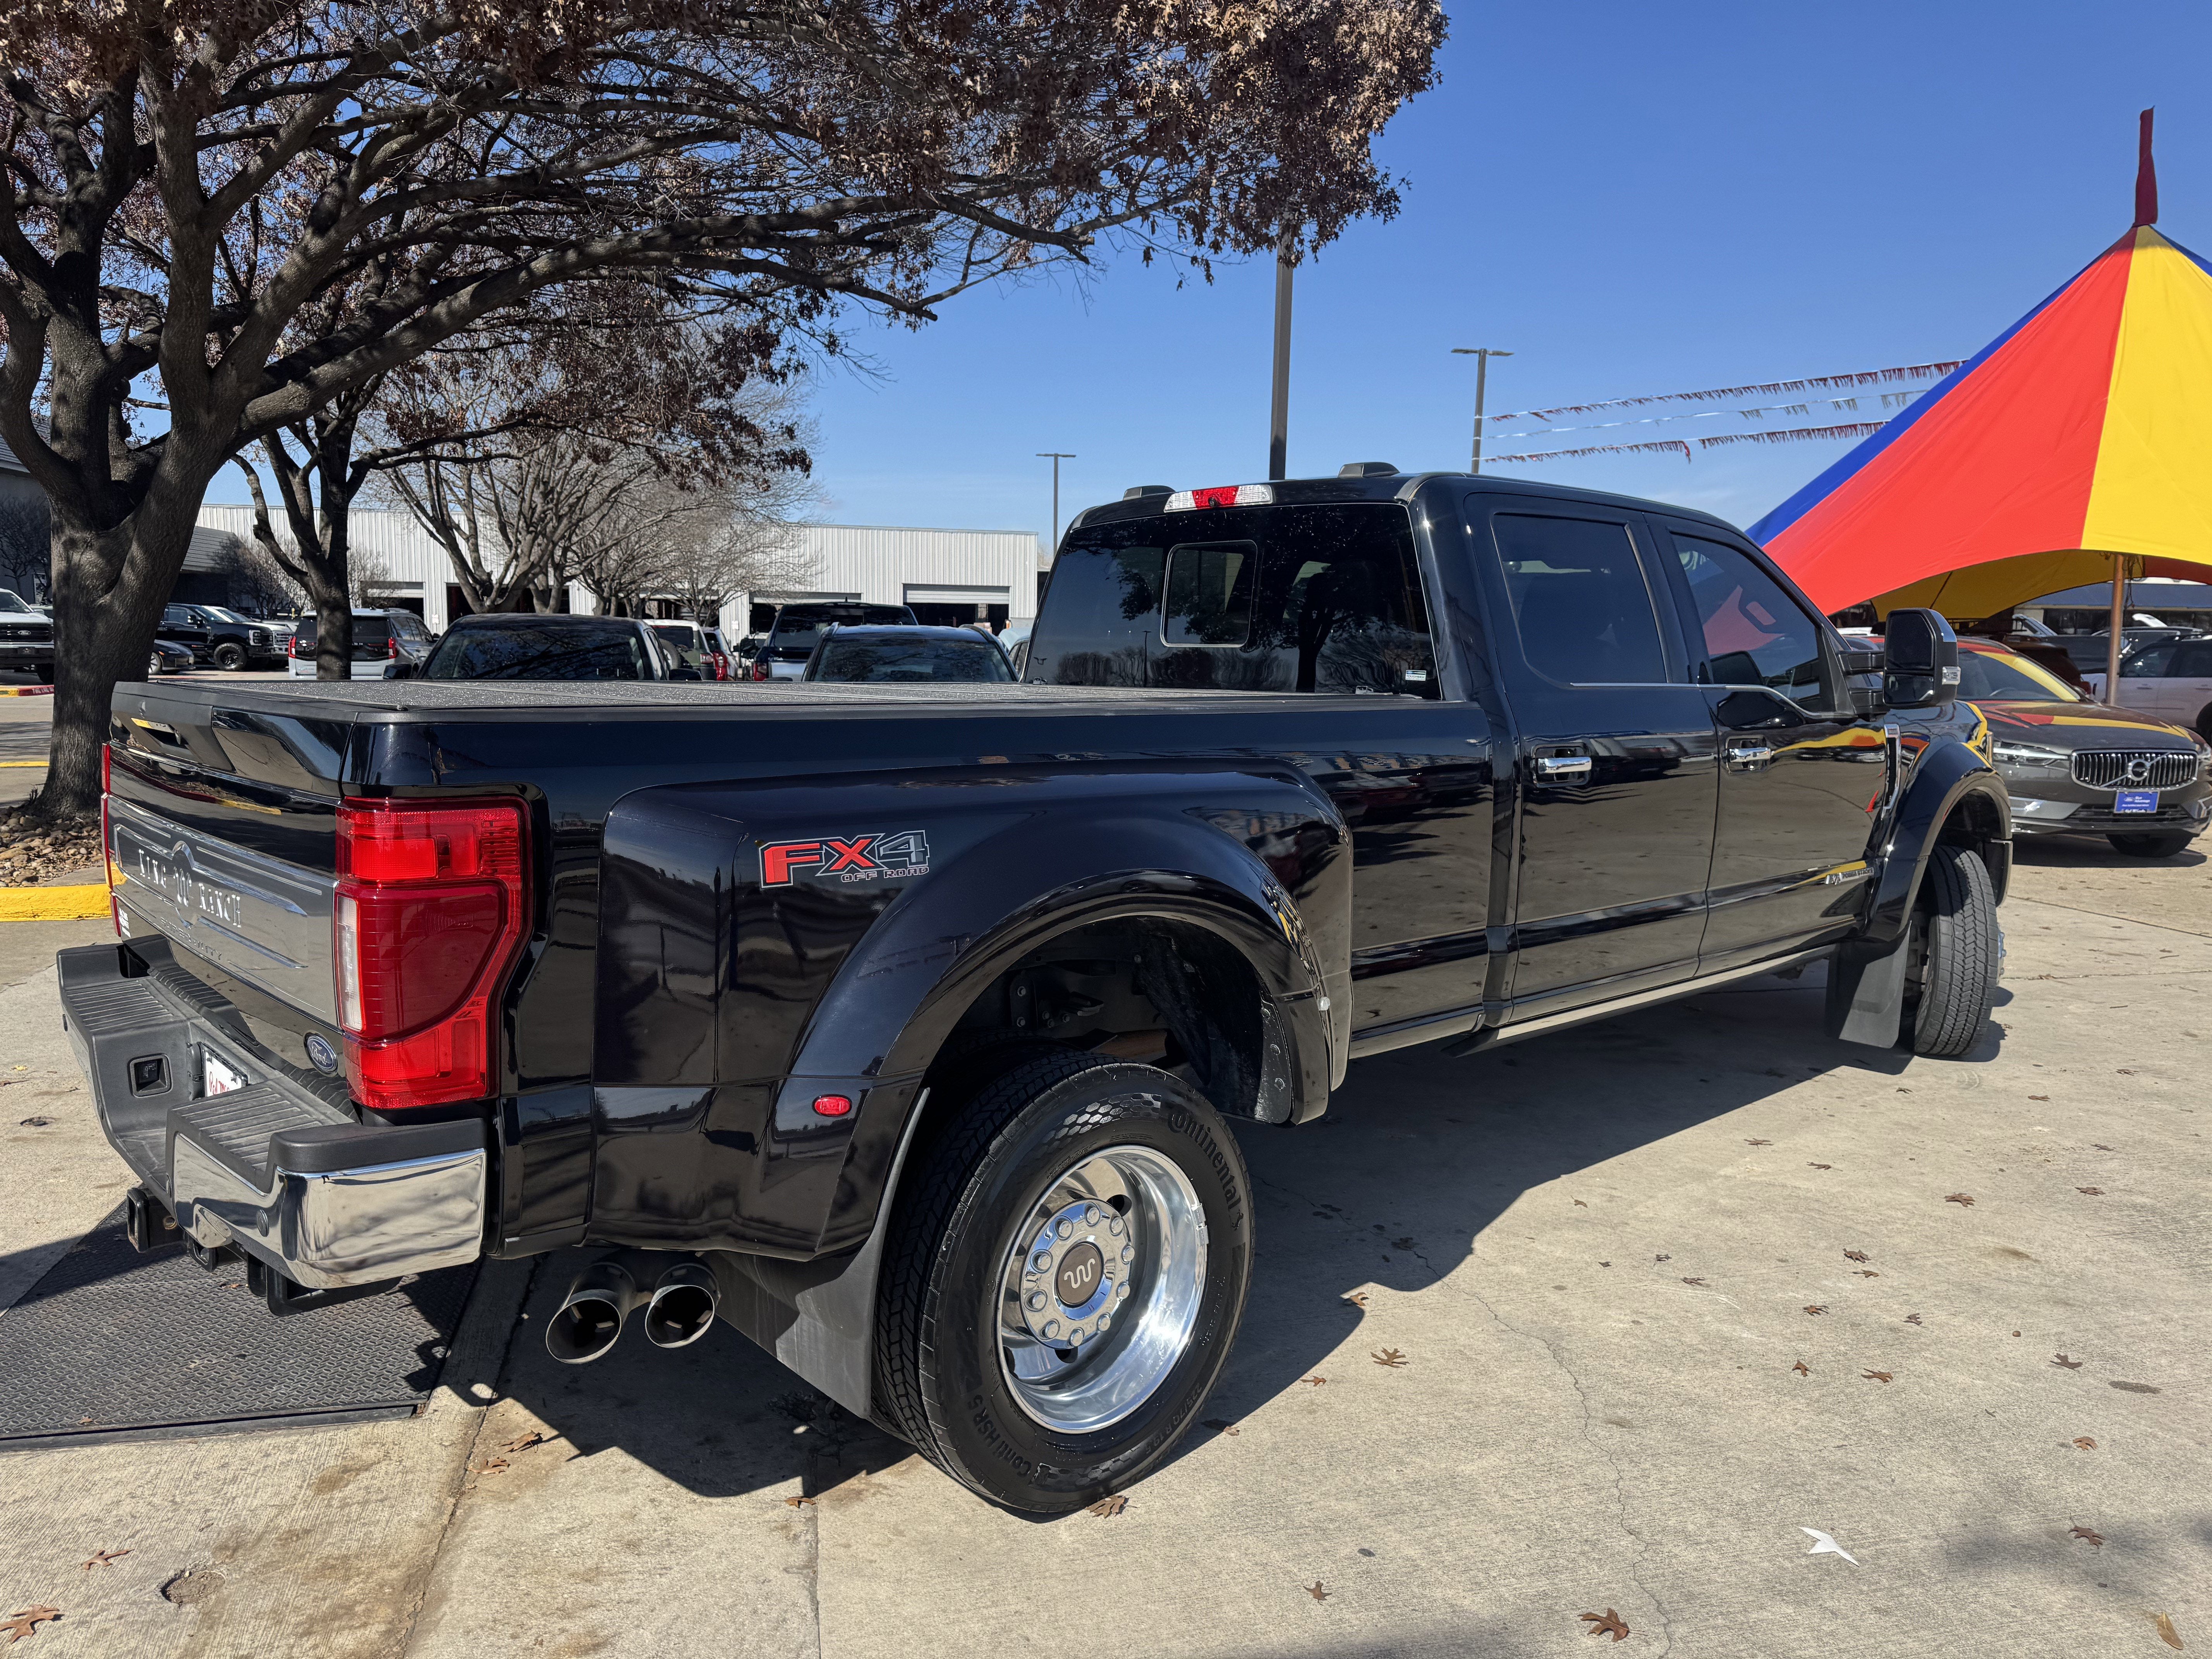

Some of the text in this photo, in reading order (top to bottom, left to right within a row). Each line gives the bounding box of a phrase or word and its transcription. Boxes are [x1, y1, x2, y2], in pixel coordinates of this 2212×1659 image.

[759, 830, 930, 888] FX4
[841, 866, 929, 883] OFF ROAD
[139, 848, 242, 928] KING RANCH
[193, 937, 222, 960] DUTY
[311, 1042, 330, 1065] Ford
[1167, 1111, 1242, 1211] Continental
[1173, 1382, 1202, 1425] 225/70
[973, 1407, 1001, 1449] HSR
[1165, 1423, 1173, 1434] R
[992, 1441, 1032, 1477] Conti
